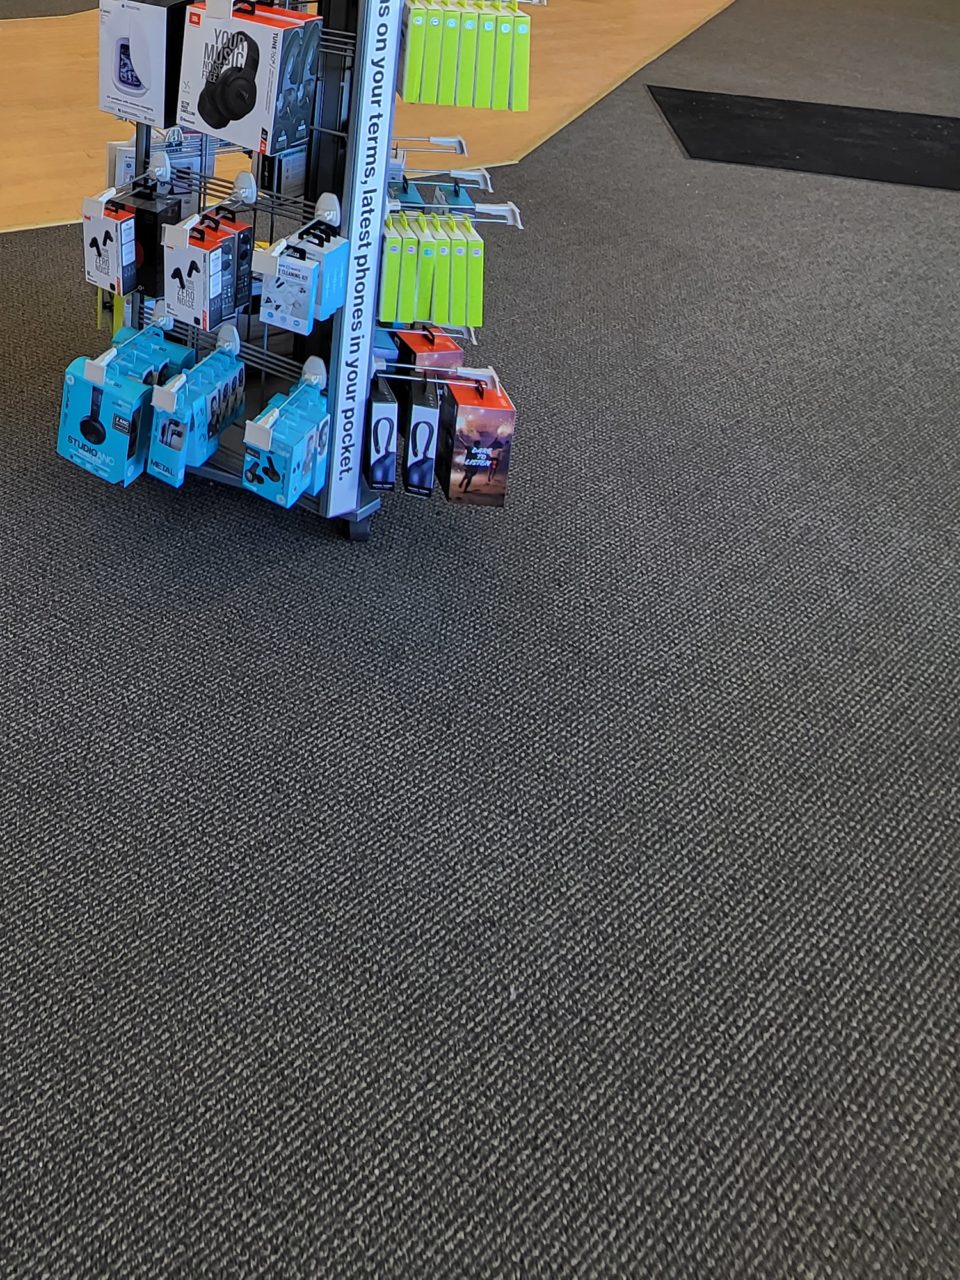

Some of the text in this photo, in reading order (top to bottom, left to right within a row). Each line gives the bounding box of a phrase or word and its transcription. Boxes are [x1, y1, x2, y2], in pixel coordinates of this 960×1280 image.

[203, 42, 244, 68] MUSIC
[214, 28, 246, 51] YOUR
[375, 22, 389, 52] on
[370, 56, 386, 108] your
[360, 112, 384, 186] terms,
[357, 188, 378, 251] latest
[351, 254, 371, 332] phones
[349, 335, 365, 355] in
[344, 357, 360, 403] your
[338, 407, 356, 482] pocket.
